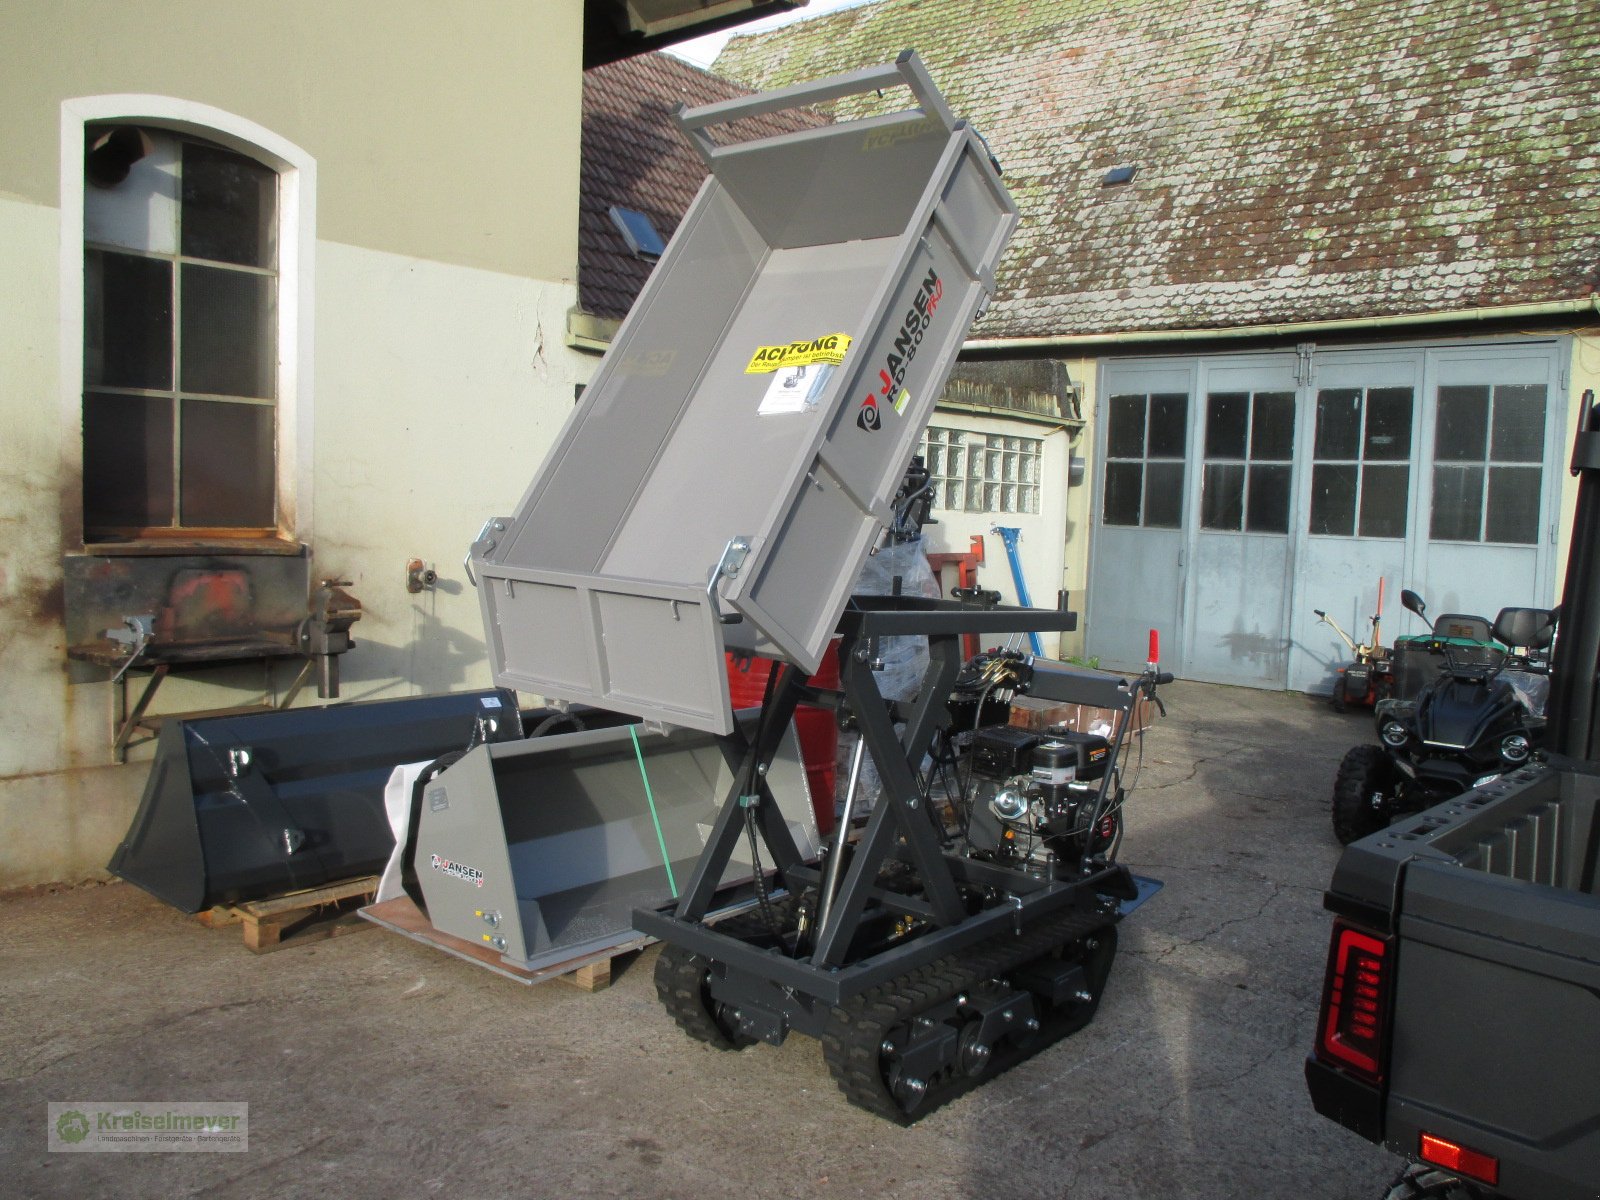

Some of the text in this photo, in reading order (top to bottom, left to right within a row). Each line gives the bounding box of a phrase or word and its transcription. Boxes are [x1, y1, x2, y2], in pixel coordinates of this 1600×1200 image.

[879, 267, 938, 395] JANSEN
[887, 314, 931, 404] RD-800
[926, 278, 943, 317] PRO
[442, 860, 483, 879] JANSEN
